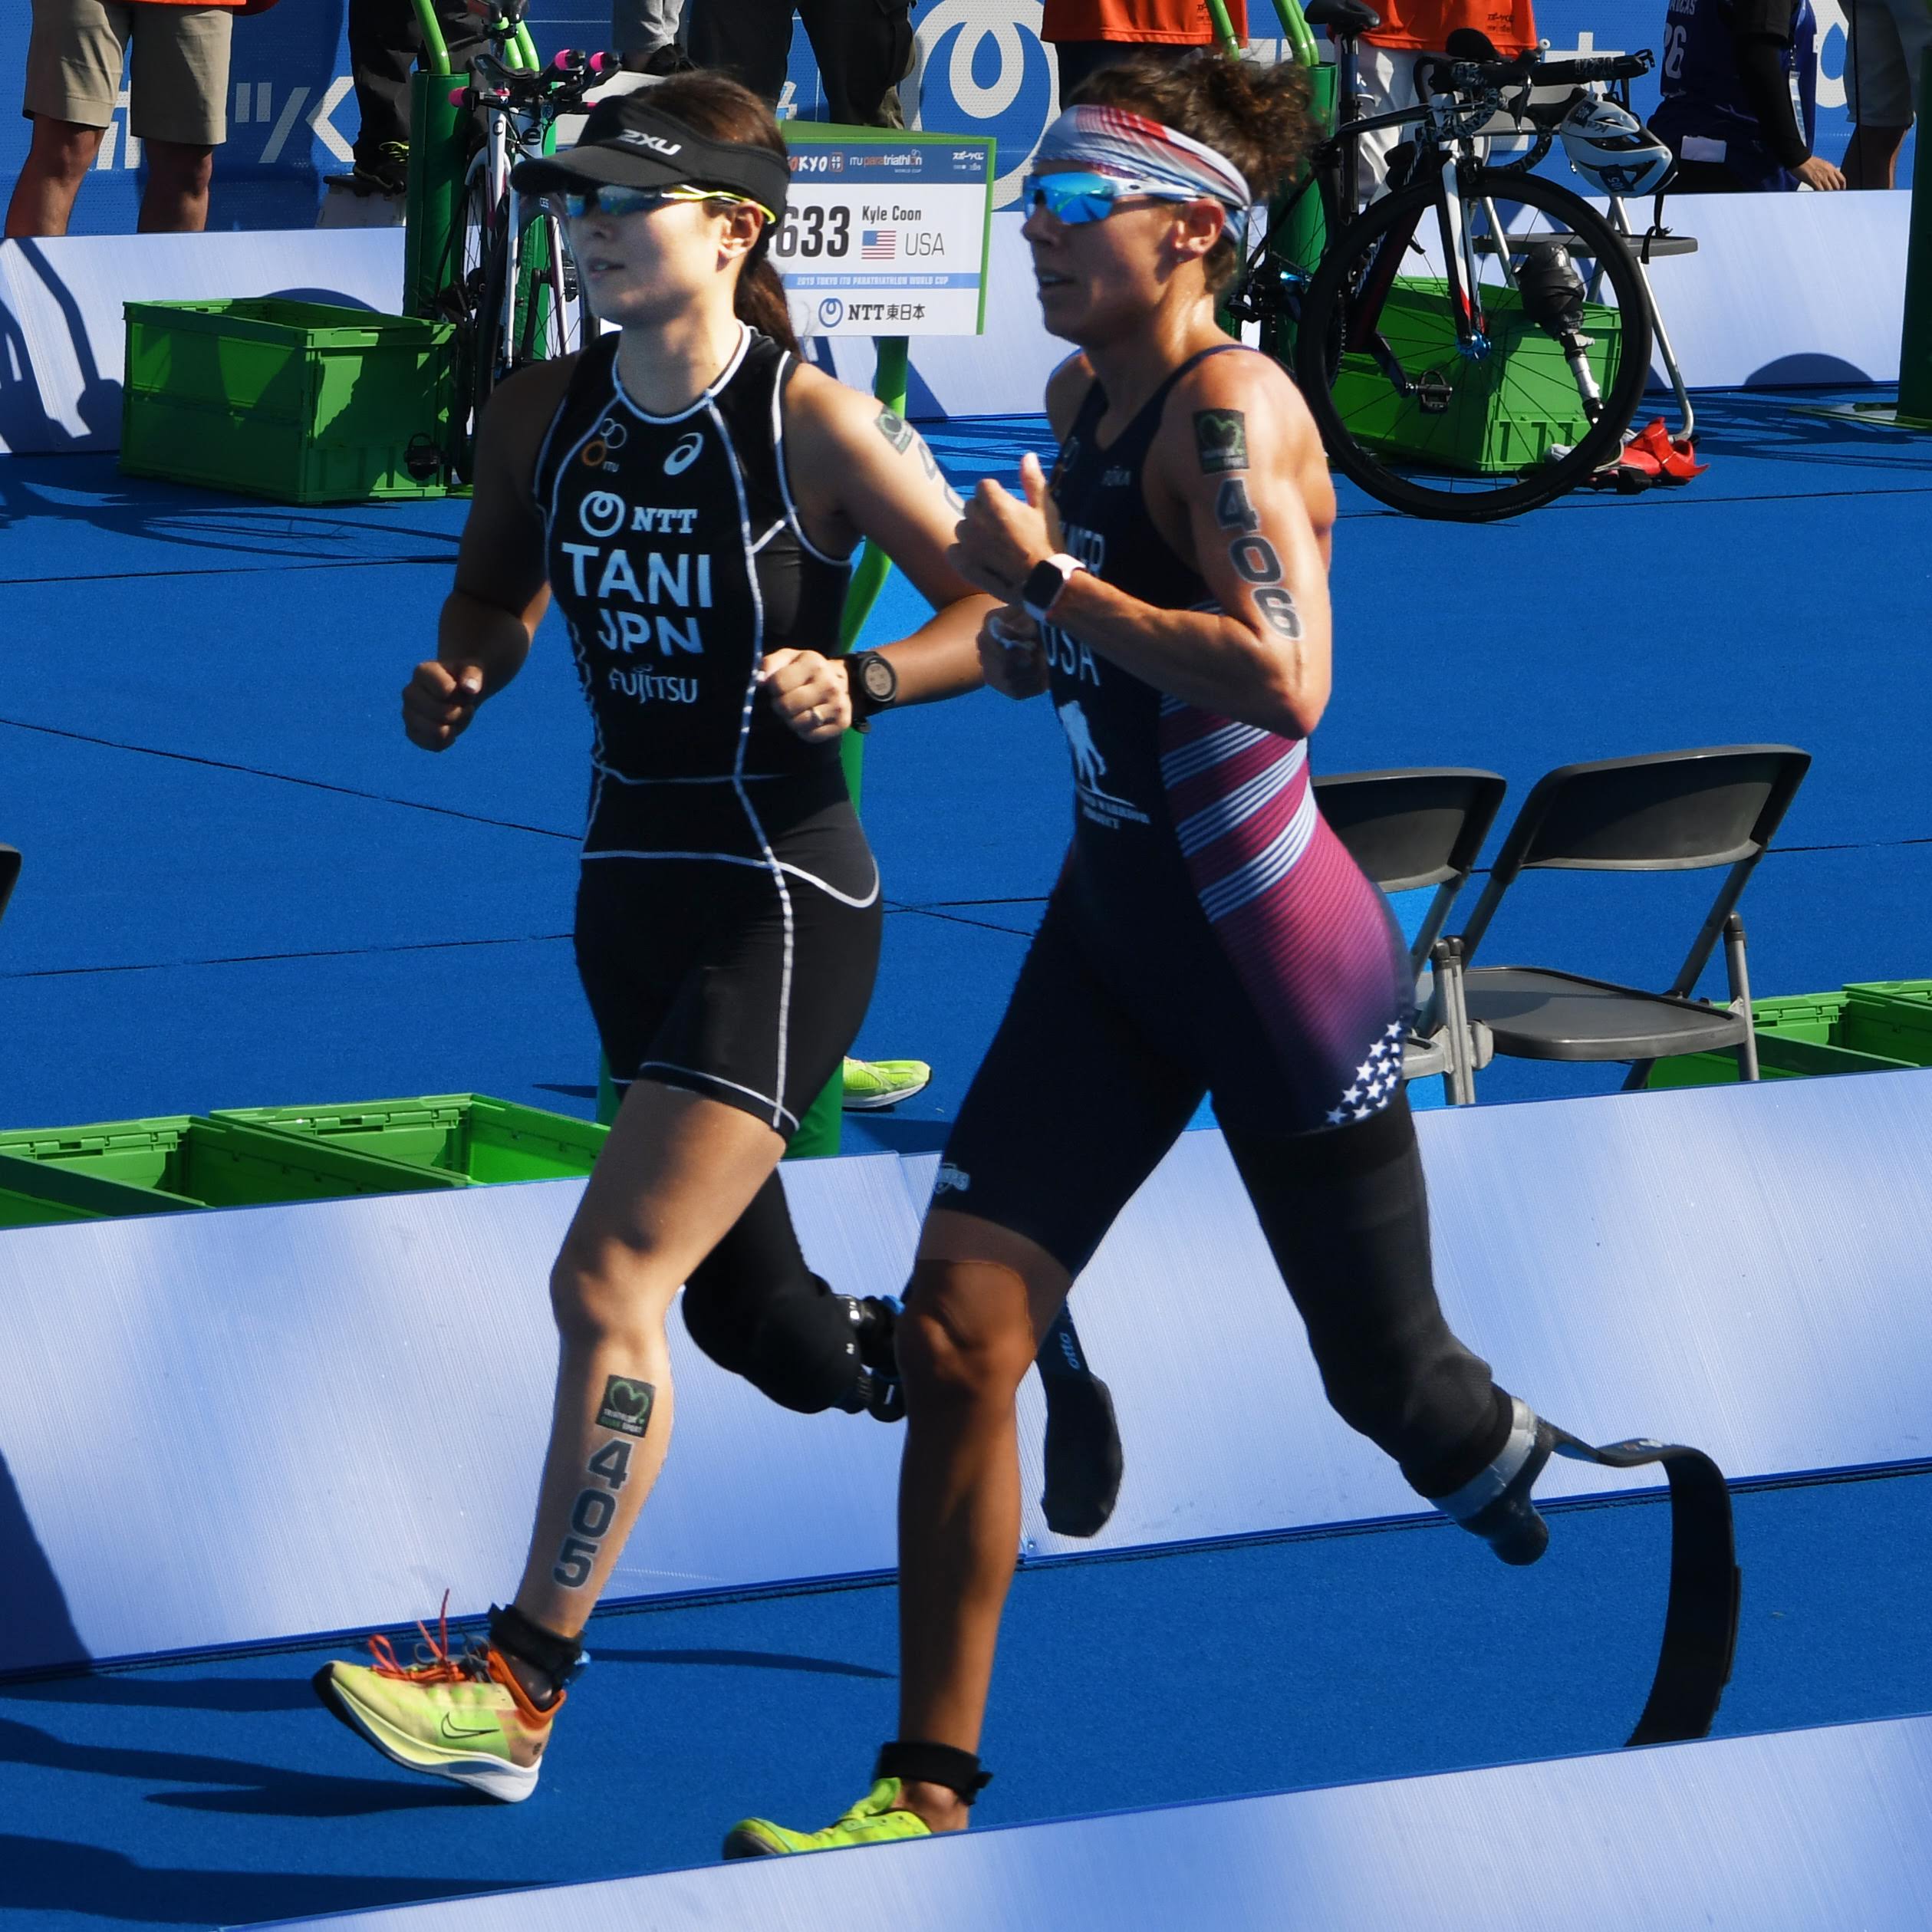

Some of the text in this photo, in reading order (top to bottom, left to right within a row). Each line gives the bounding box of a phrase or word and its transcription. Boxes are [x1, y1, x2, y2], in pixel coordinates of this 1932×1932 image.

[616, 129, 682, 156] 2XU
[787, 156, 828, 172] OKYO
[775, 206, 850, 258] 633
[862, 205, 921, 224] Kyle Coon
[905, 232, 945, 255] USA
[816, 276, 838, 285] TOKYO
[852, 276, 908, 285] PARATRIATHLON
[910, 276, 933, 285] WORLD
[934, 276, 949, 285] CUP
[630, 506, 699, 534] NTT
[561, 541, 713, 608] TANI
[1216, 477, 1302, 641] 406
[597, 608, 705, 657] JPN
[1040, 623, 1101, 686] USA
[608, 664, 699, 704] FUJITSU
[553, 1438, 634, 1588] 405
